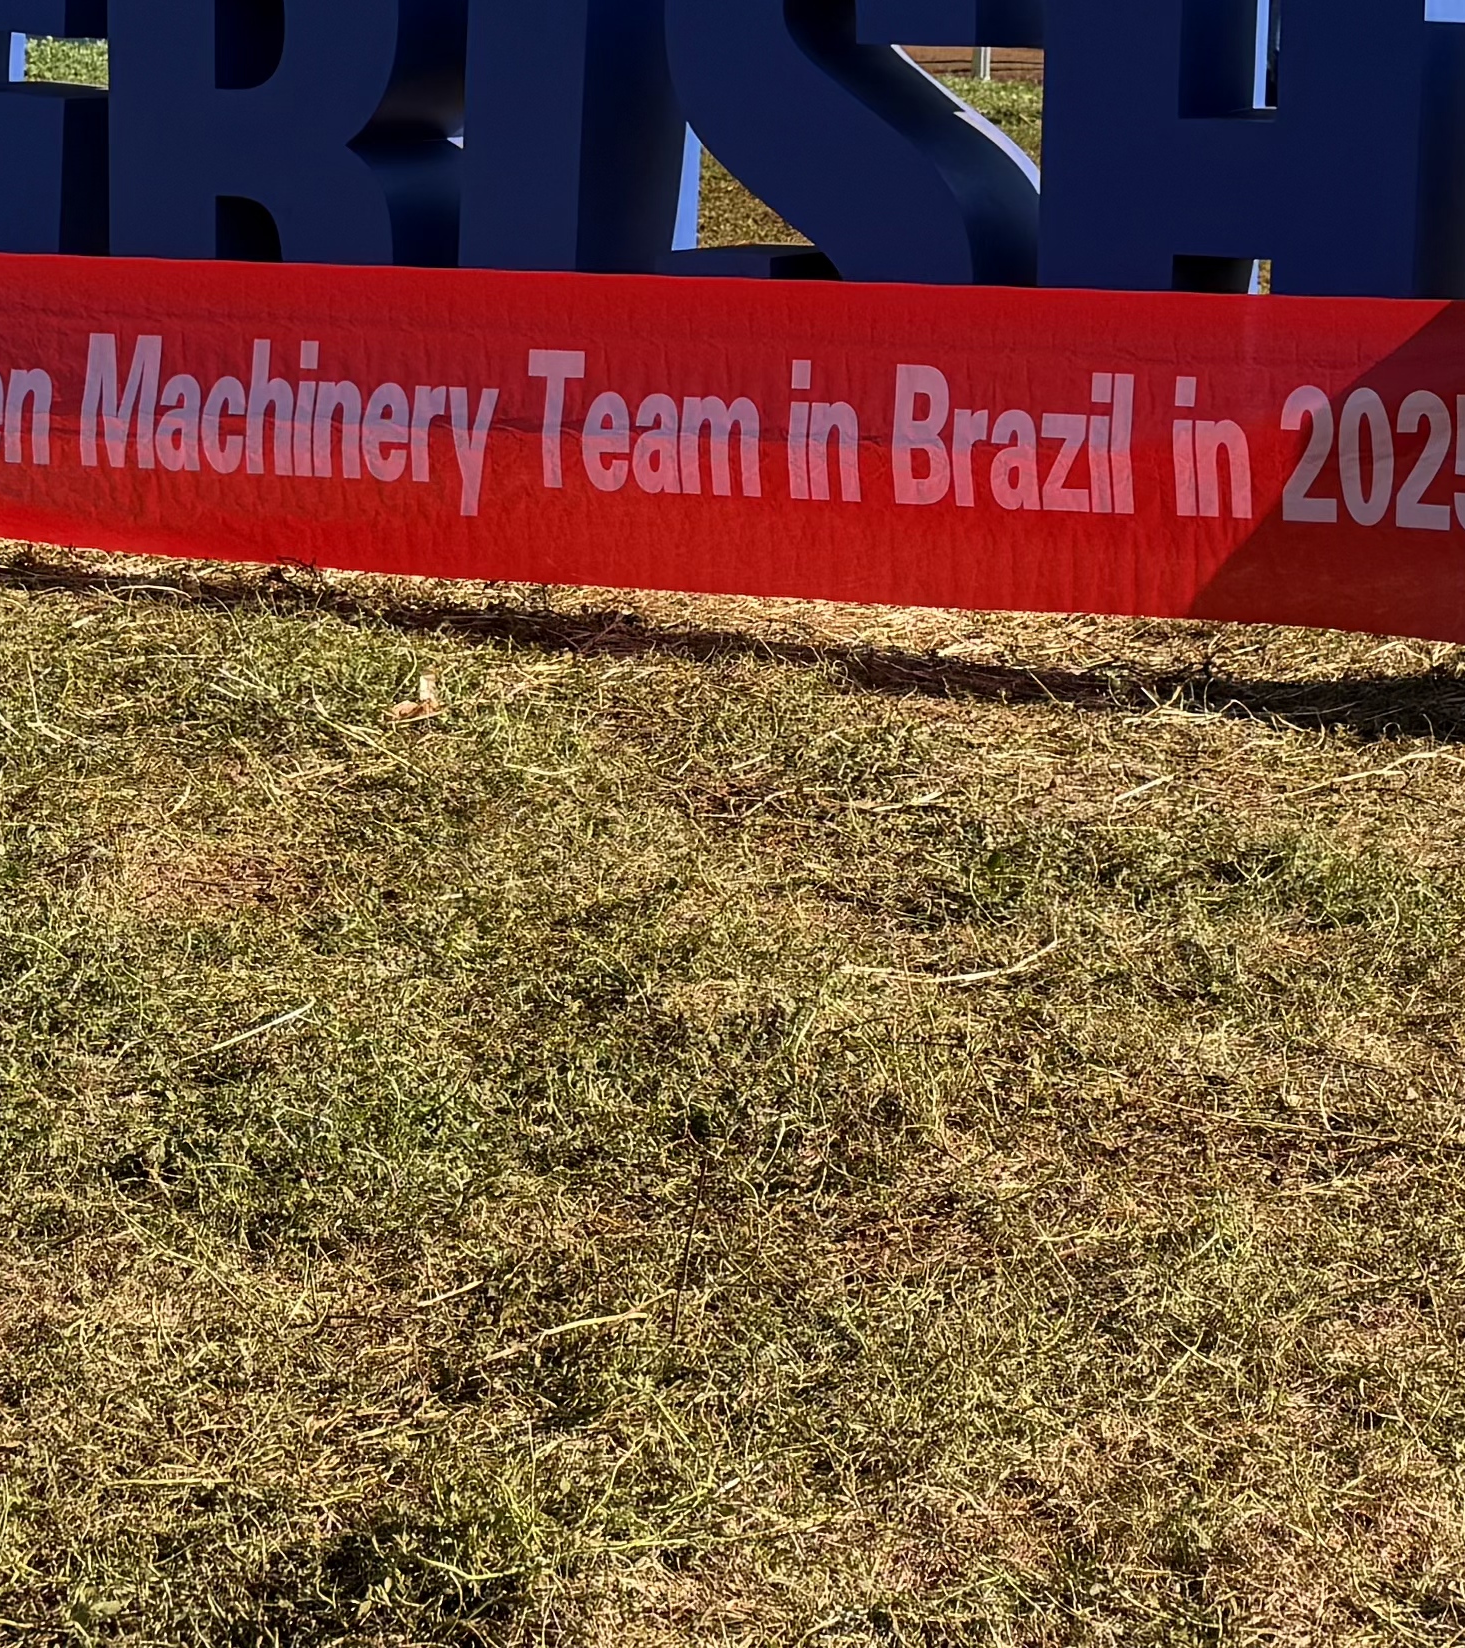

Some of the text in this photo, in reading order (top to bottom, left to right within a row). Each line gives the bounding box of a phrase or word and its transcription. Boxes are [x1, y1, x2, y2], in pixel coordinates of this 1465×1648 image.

[79, 332, 499, 517] Machinery
[528, 349, 762, 498] Team
[787, 359, 862, 503] in
[893, 363, 1135, 515] Brazil
[1171, 376, 1252, 520] in
